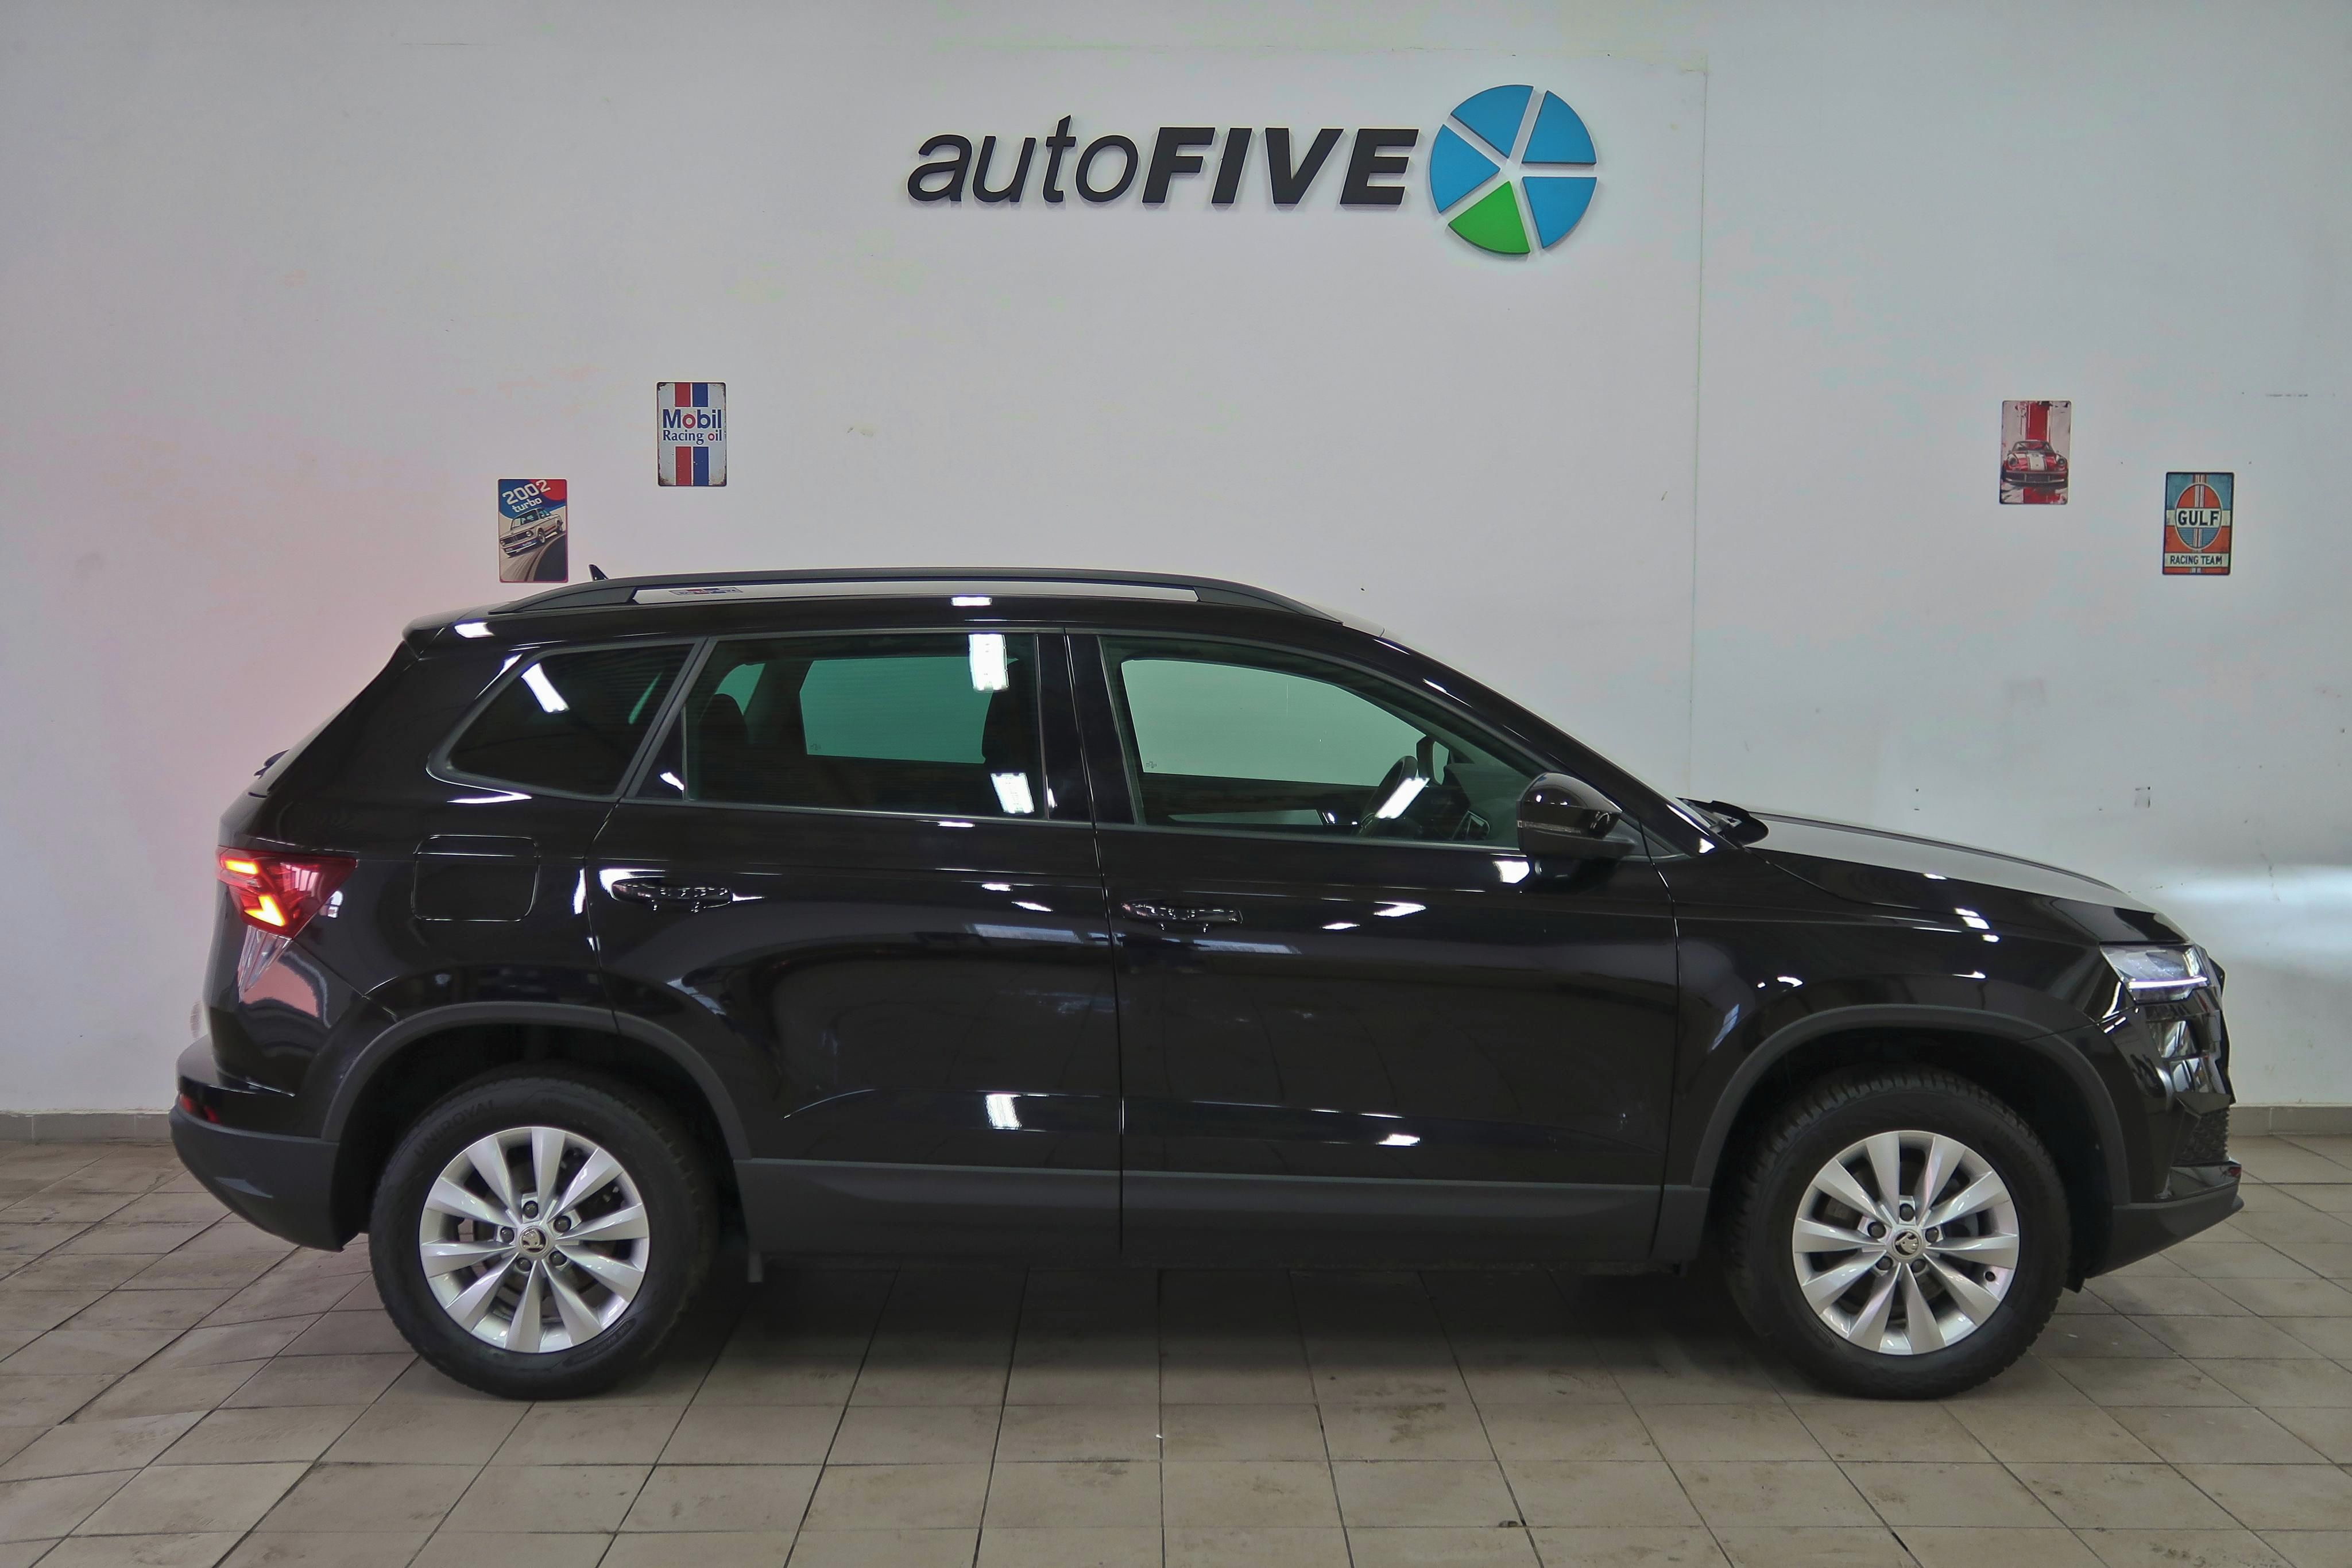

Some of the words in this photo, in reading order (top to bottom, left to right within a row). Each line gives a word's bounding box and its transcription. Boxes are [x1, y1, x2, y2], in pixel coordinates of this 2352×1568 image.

[907, 115, 1419, 205] autoFIVE
[663, 409, 722, 428] Mobil
[663, 429, 704, 445] Racing
[707, 429, 722, 441] oil
[502, 479, 551, 505] 2002
[512, 497, 542, 513] turbo
[2178, 510, 2219, 526] GULF
[2170, 555, 2199, 565] RACING
[2201, 555, 2222, 565] TEAM
